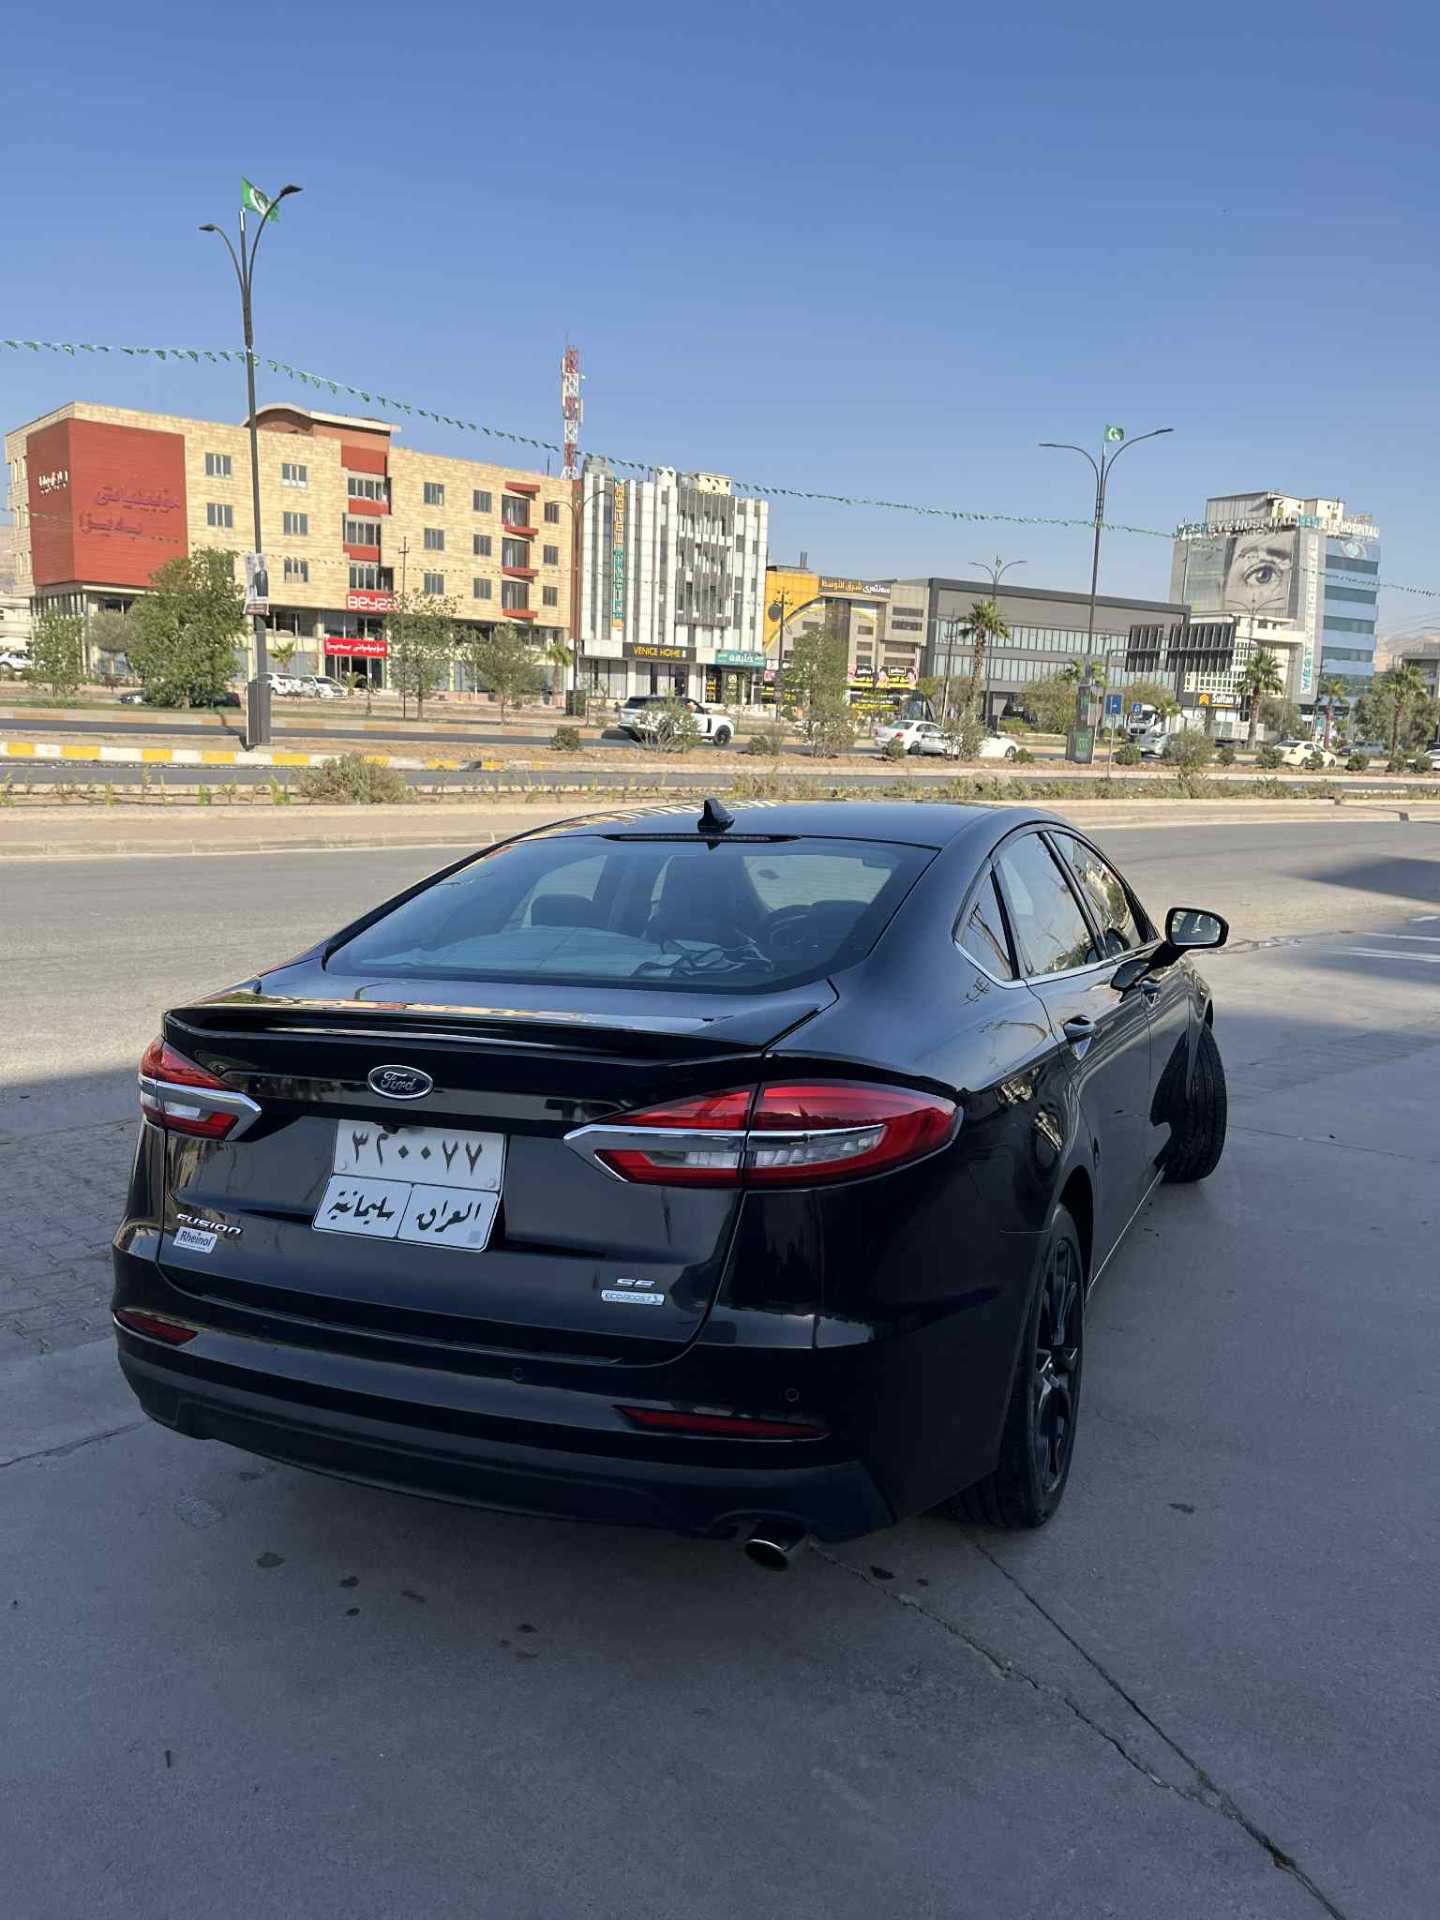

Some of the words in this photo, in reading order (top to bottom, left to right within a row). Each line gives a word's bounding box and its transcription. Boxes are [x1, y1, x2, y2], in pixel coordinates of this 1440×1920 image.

[633, 646, 657, 657] VENICE
[660, 648, 682, 657] HOME
[1212, 693, 1234, 704] Sultan
[381, 1071, 416, 1090] Ford
[416, 1200, 482, 1233] العراق
[617, 1278, 656, 1288] SE
